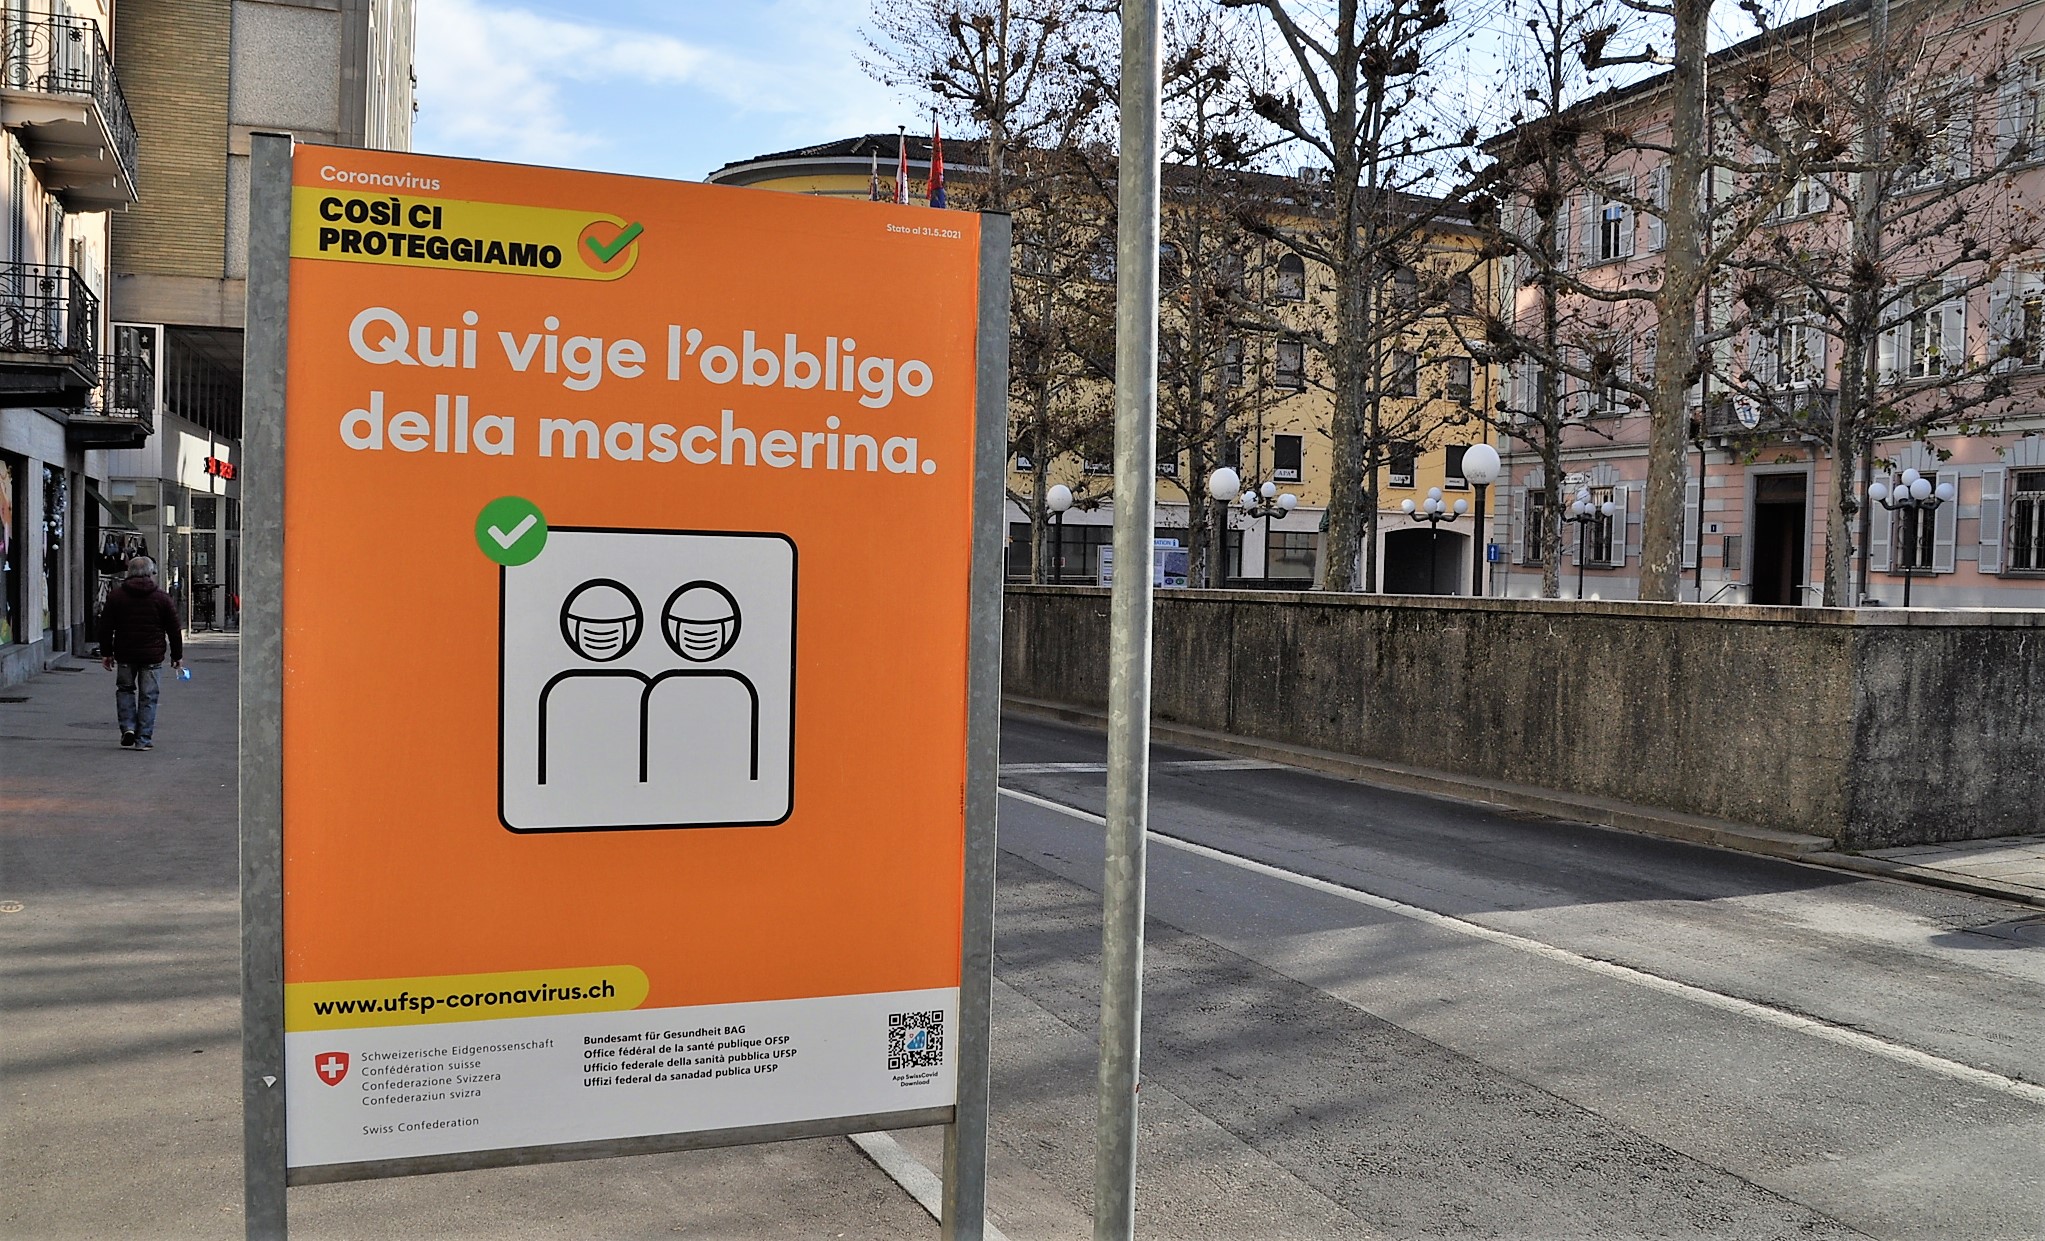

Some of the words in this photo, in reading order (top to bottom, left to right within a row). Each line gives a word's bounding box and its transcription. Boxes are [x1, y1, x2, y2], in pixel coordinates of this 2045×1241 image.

[320, 165, 440, 190] Coronavirus
[320, 197, 400, 226] COSÌ
[408, 204, 442, 230] CI
[886, 224, 910, 234] Stato
[922, 228, 960, 239] 31.5.2021
[319, 227, 562, 269] PROTEGGIAMO
[348, 306, 479, 369] Qui
[498, 316, 646, 392] vige
[339, 391, 515, 456] della
[538, 409, 937, 476] mascherina.
[314, 980, 616, 1016] www.ufsp-coronavirus.ch
[584, 1033, 642, 1045] Bundesamt
[645, 1031, 660, 1041] für
[663, 1027, 722, 1039] Gesundheit
[724, 1025, 746, 1035] BAG
[361, 1047, 448, 1062] Schweizerische
[452, 1038, 554, 1056] Eidgenossenschaft
[584, 1048, 615, 1059] Office
[619, 1045, 656, 1056] fédéral
[659, 1044, 671, 1054] de
[674, 1044, 684, 1052] la
[686, 1041, 715, 1051] santé
[717, 1038, 762, 1051] publique
[765, 1036, 790, 1045] OFSP
[361, 1062, 444, 1076] Confédération
[448, 1060, 481, 1070] suisse
[584, 1062, 618, 1073] Ufficio
[621, 1059, 664, 1070] federale
[667, 1057, 692, 1067] della
[695, 1054, 725, 1065] sanità
[728, 1051, 770, 1064] pubblica
[773, 1049, 797, 1059] UFSP
[361, 1076, 452, 1091] Confederazione
[456, 1072, 501, 1084] Svizzera
[584, 1076, 612, 1087] Uffizi
[615, 1073, 651, 1085] federal
[655, 1073, 667, 1082] da
[670, 1070, 712, 1081] sanadad
[715, 1066, 750, 1078] publica
[754, 1064, 778, 1074] UFSP
[362, 1091, 446, 1106] Confederaziun
[450, 1088, 481, 1100] svizra
[362, 1124, 394, 1135] Swiss
[398, 1117, 479, 1132] Confederation
